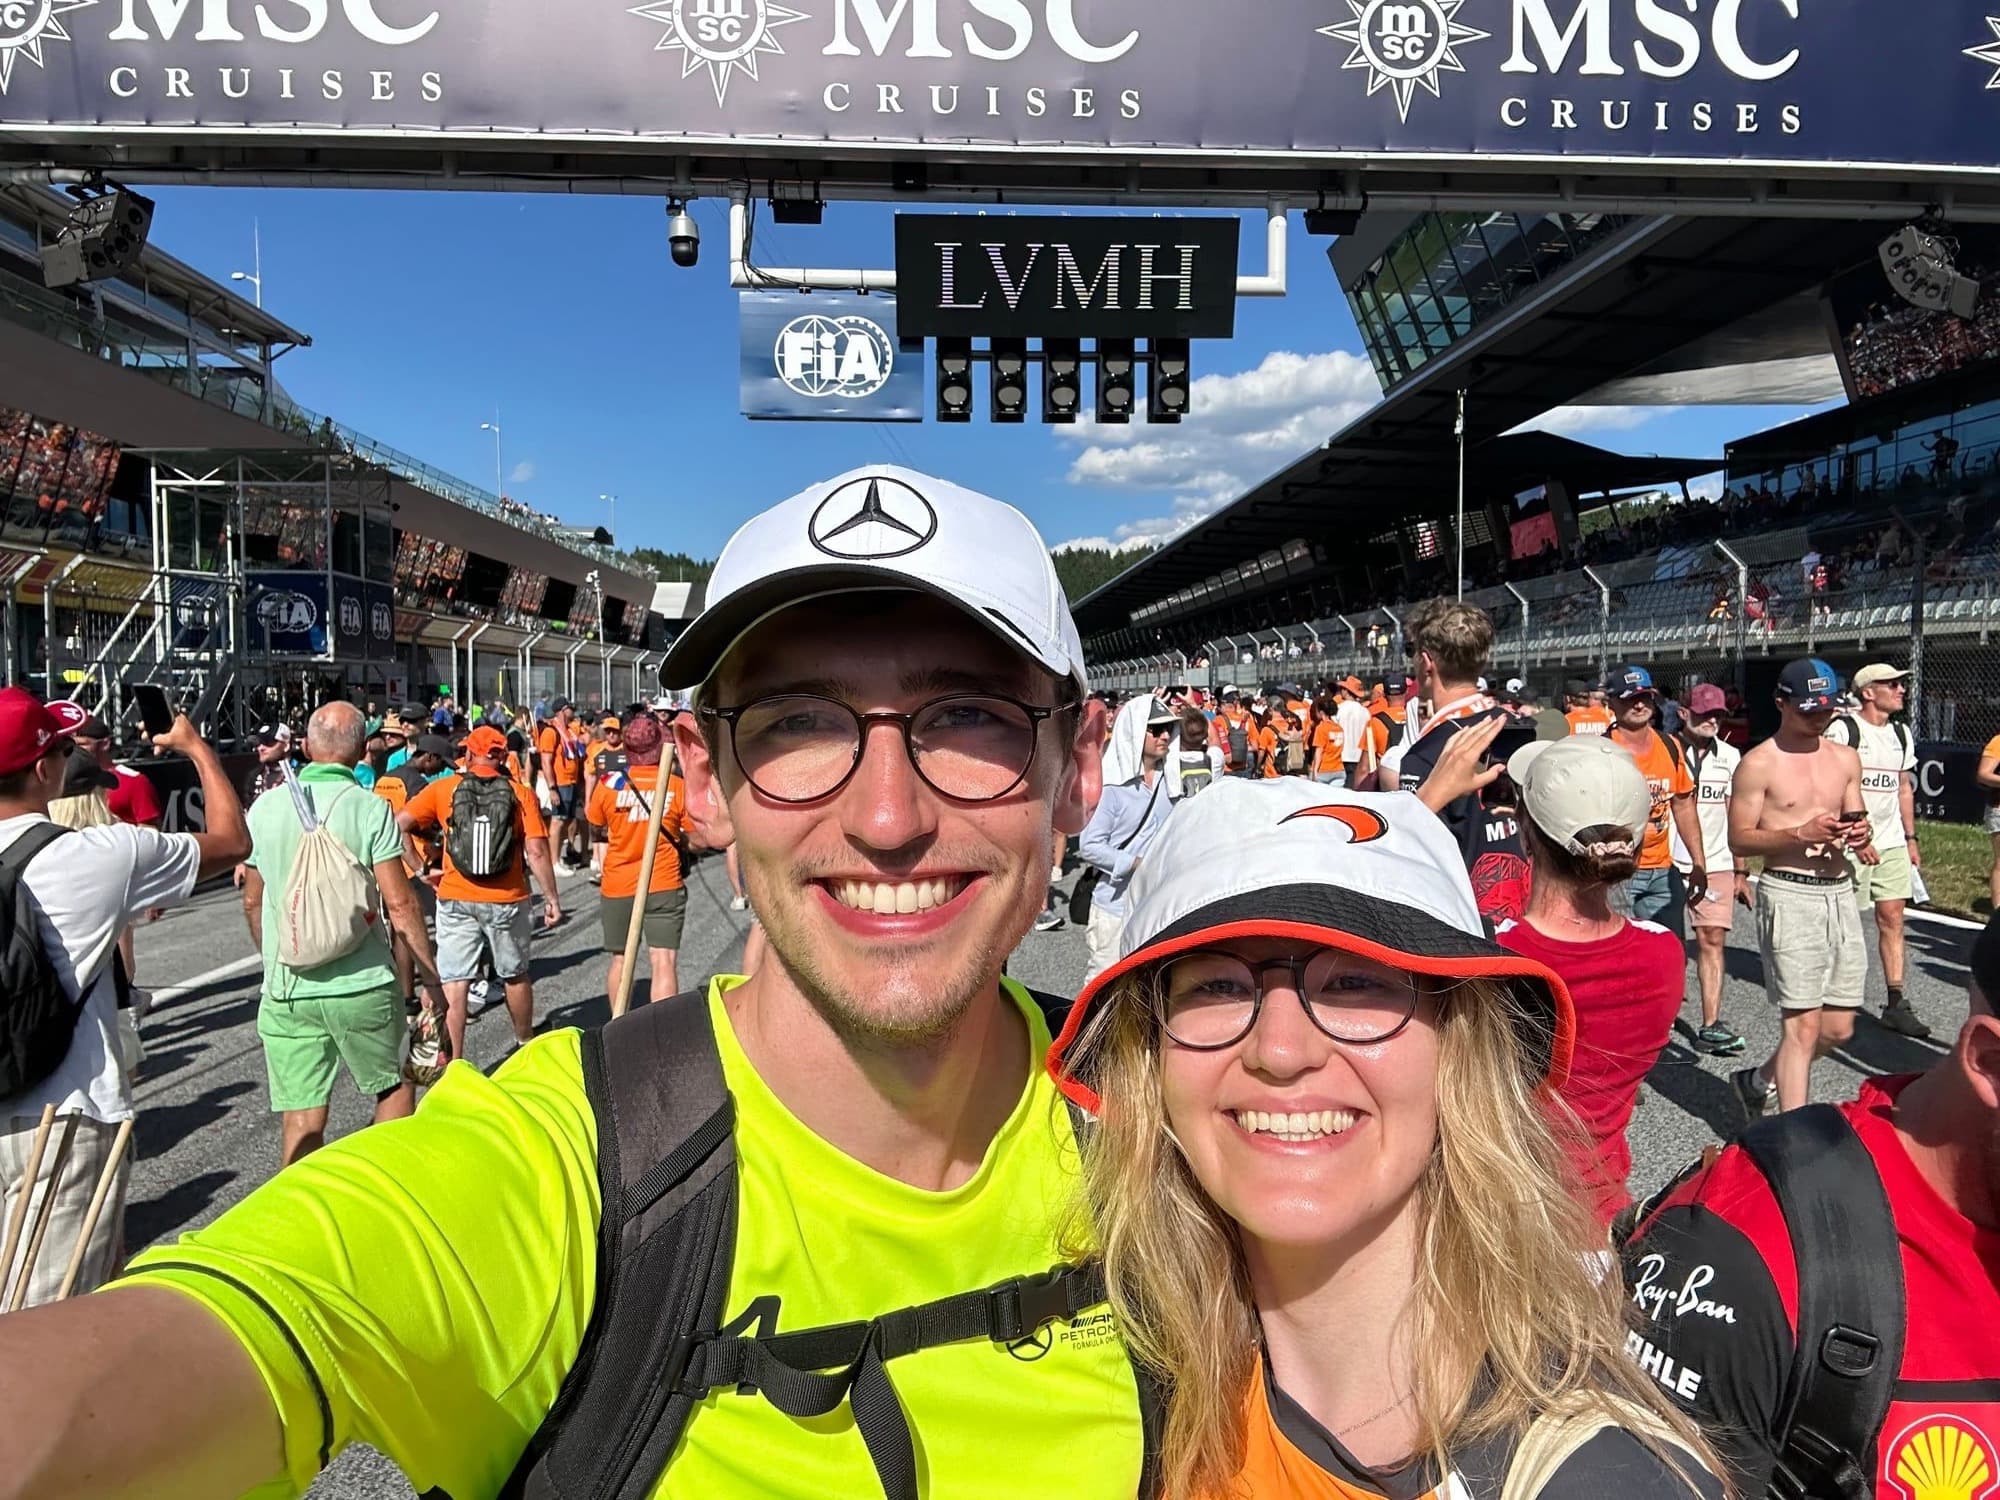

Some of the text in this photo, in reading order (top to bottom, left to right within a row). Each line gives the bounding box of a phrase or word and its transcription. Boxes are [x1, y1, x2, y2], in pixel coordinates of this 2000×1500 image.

[1500, 0, 1799, 81] MSC
[109, 66, 442, 101] CRUISES
[823, 83, 1140, 119] CRUISES
[1501, 98, 1801, 134] CRUISES
[933, 242, 1201, 312] LVMH
